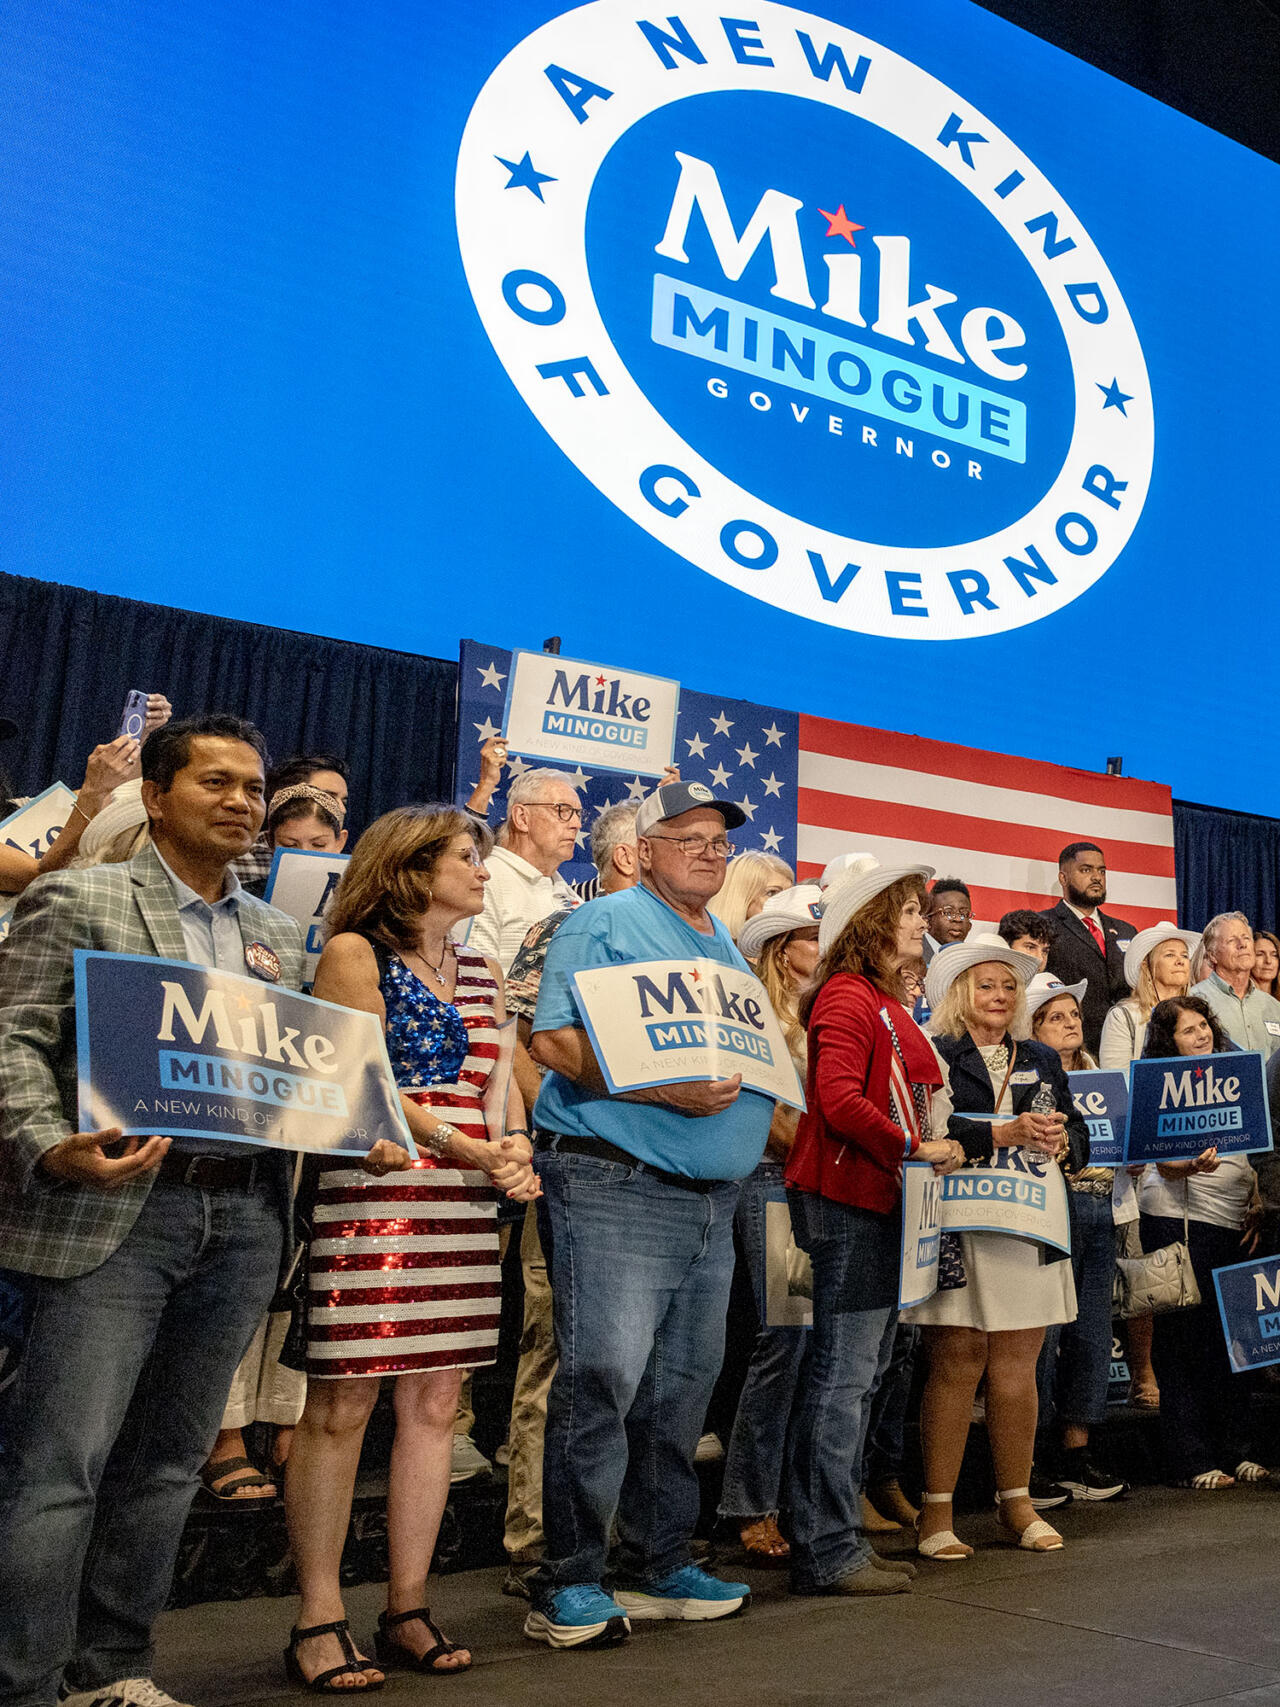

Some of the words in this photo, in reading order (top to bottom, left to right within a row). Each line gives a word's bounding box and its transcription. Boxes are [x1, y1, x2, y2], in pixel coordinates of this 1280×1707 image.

[543, 63, 615, 124] A
[636, 16, 872, 94] NEW
[936, 111, 1109, 325] KIND
[654, 150, 1028, 381] Mike
[672, 293, 1012, 447] MINOGUE
[501, 269, 610, 398] OF
[638, 463, 1129, 617] GOVERNOR
[707, 377, 983, 480] GOVERNOR
[546, 669, 651, 722] Mike
[547, 715, 645, 745] MINOGUE
[632, 972, 765, 1030] Mike
[157, 981, 339, 1074] Mike
[655, 1025, 770, 1062] MINOGUE
[171, 1058, 341, 1109] MINOGUE
[1159, 1066, 1241, 1110] Mike
[134, 1099, 149, 1113] A
[155, 1100, 202, 1115] NEW
[207, 1105, 249, 1122] KIND
[253, 1110, 274, 1125] OF
[1162, 1111, 1238, 1133] MINOGUE
[1152, 1143, 1174, 1151] NEW
[1175, 1140, 1196, 1150] KIND
[1198, 1139, 1209, 1149] OF
[1209, 1133, 1251, 1147] GOVERNOR
[948, 1179, 1043, 1205] INOGUE
[1252, 1347, 1260, 1355] A
